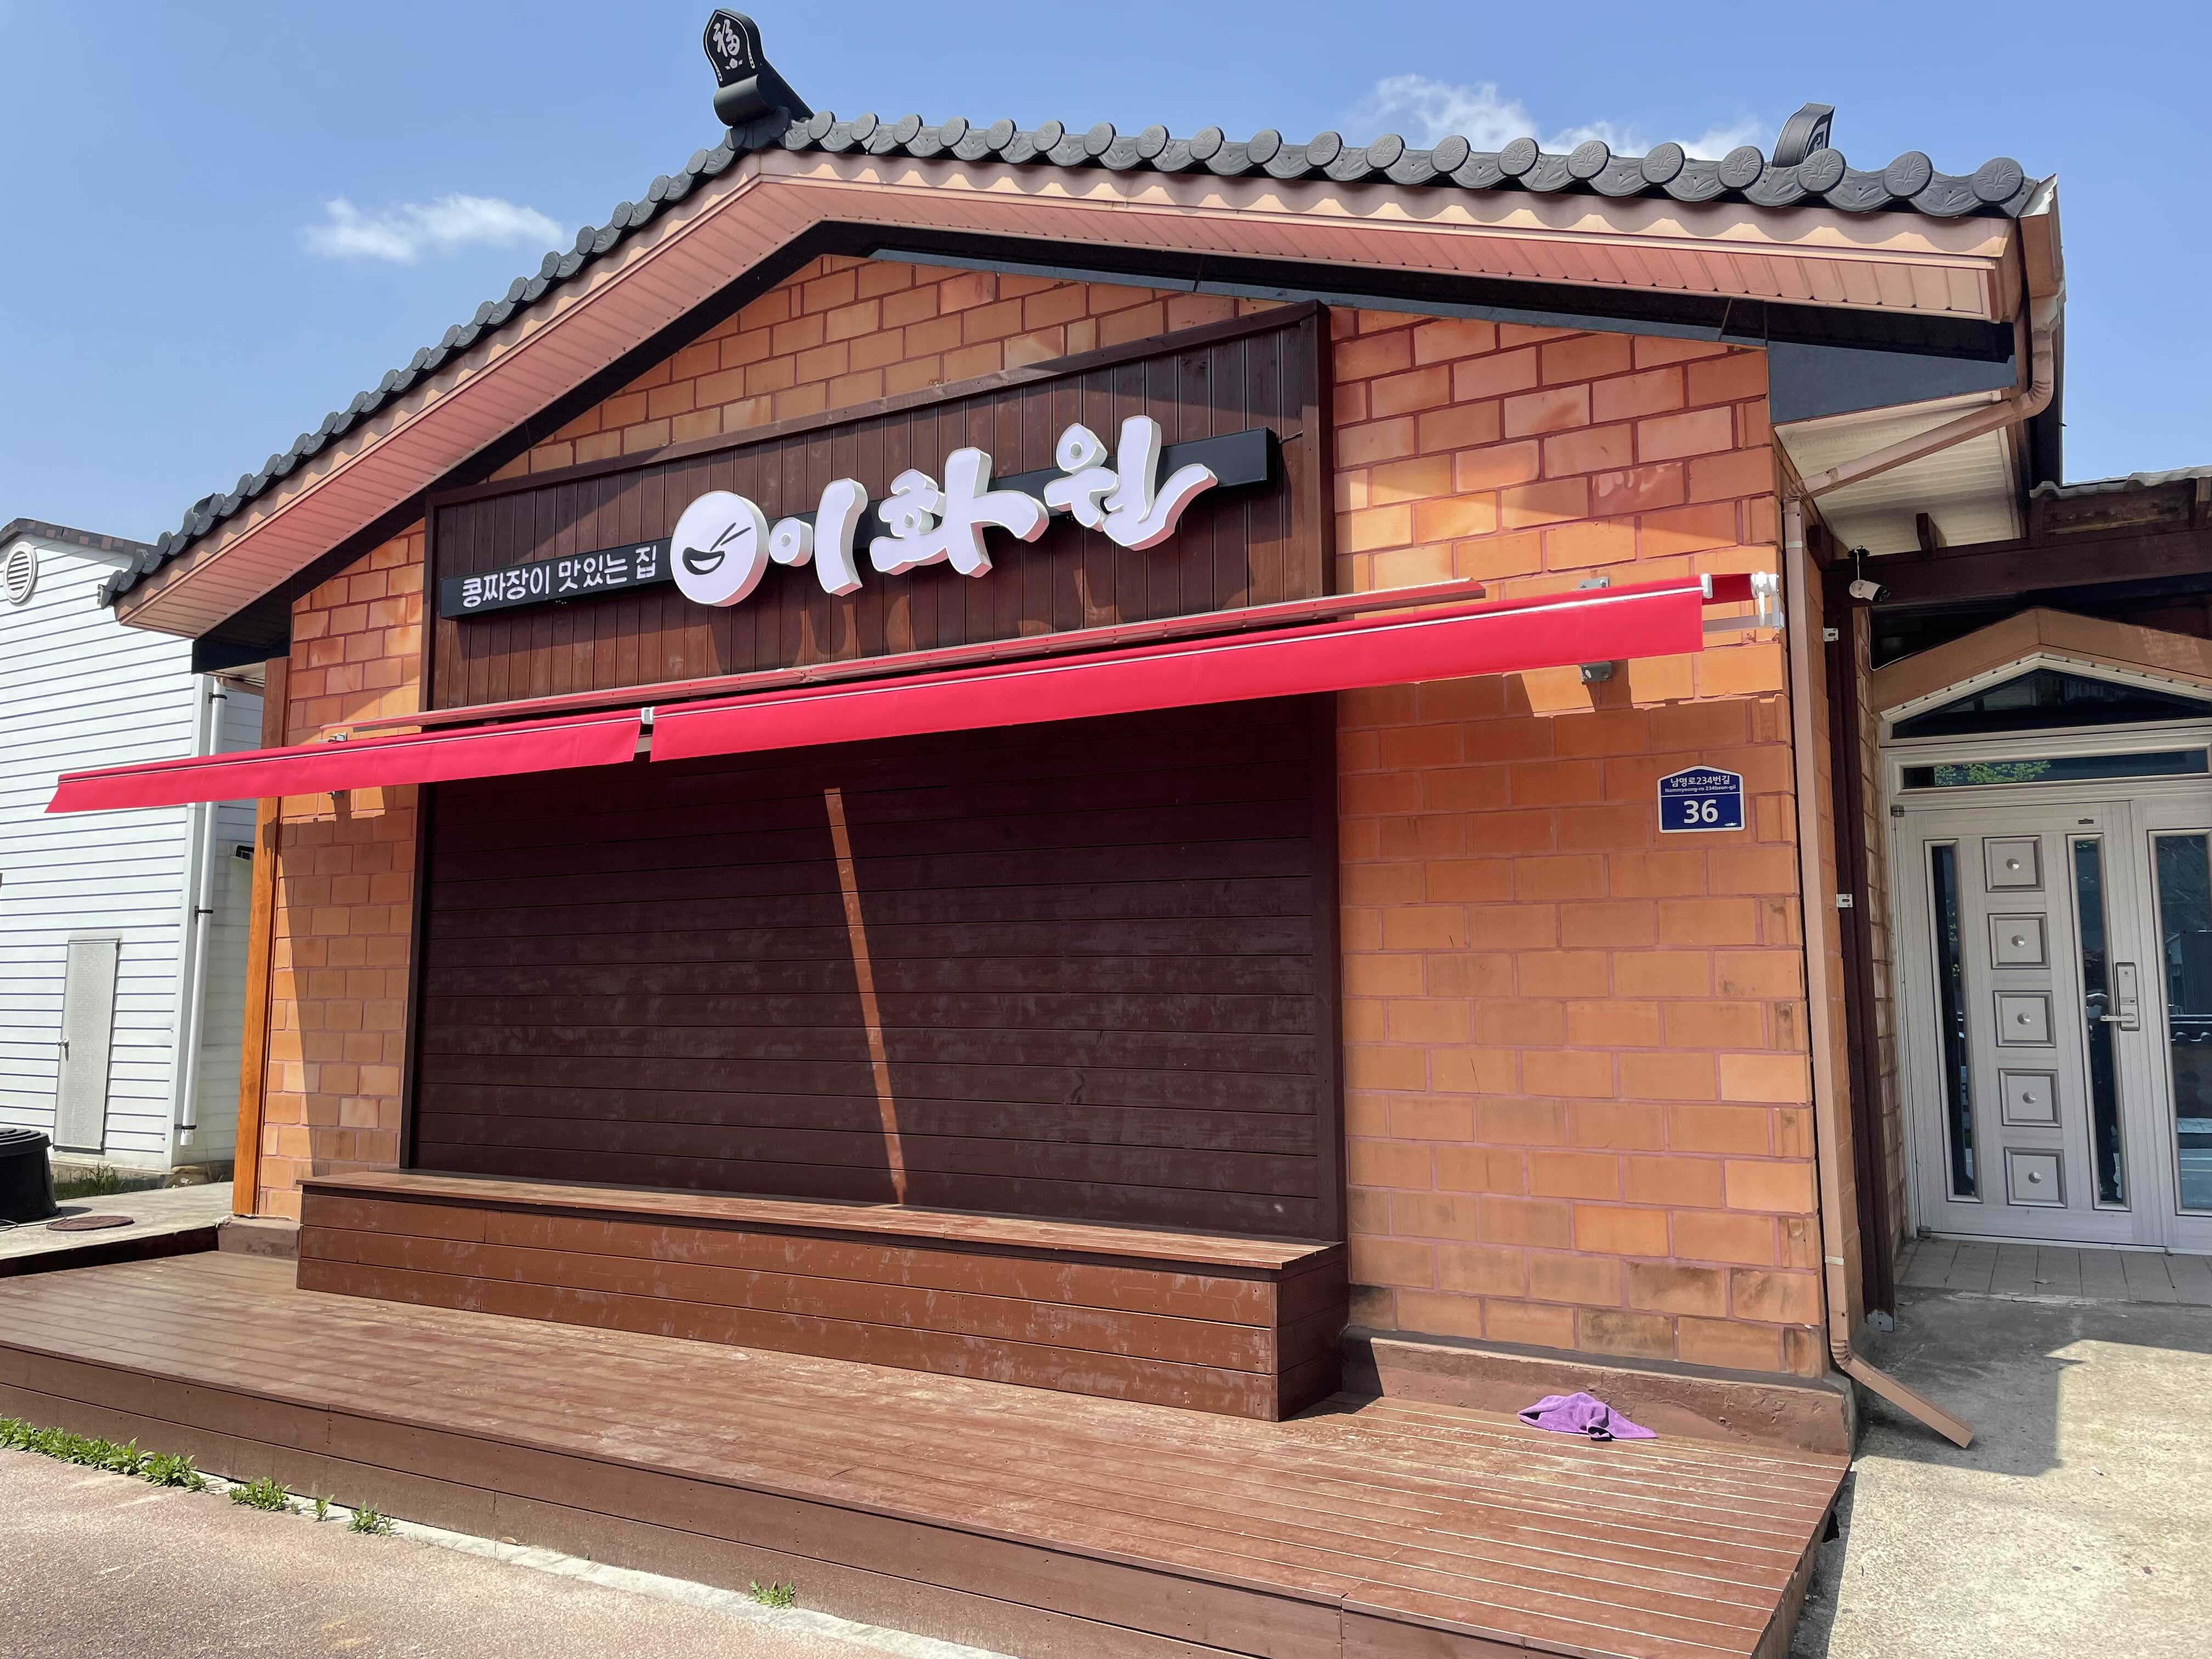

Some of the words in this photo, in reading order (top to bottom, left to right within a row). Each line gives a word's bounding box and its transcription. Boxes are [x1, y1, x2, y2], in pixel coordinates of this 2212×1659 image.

[769, 415, 1218, 596] 이화원
[462, 565, 549, 608] 콩짜장이
[558, 553, 628, 592] 맛있는
[635, 545, 657, 579] 집
[1670, 775, 1730, 787] 남명로234번길
[1684, 799, 1718, 823] 36
